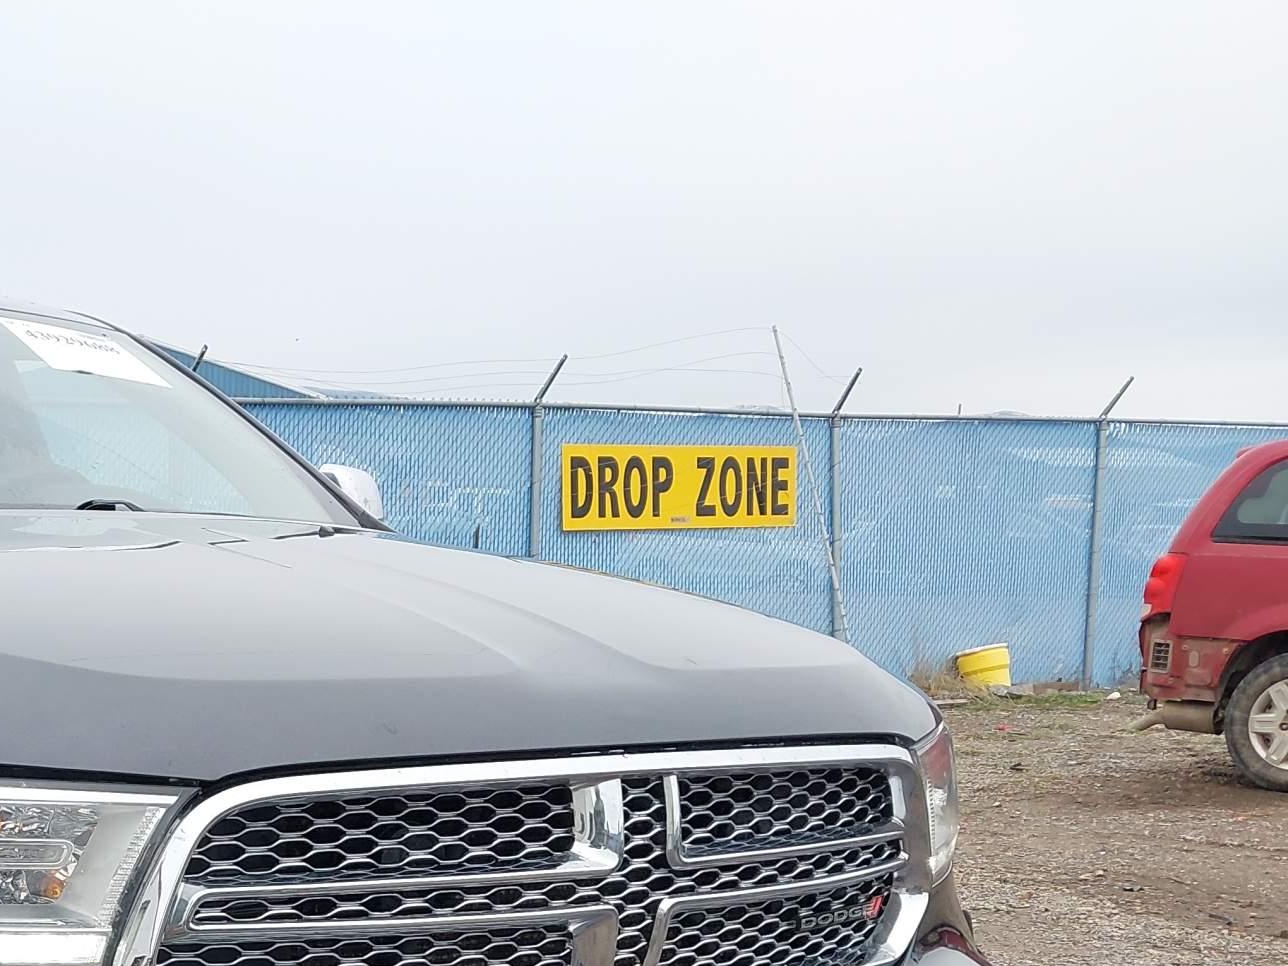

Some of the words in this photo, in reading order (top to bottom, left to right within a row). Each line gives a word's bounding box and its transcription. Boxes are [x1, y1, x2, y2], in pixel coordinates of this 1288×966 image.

[570, 455, 674, 518] DROP
[695, 456, 790, 517] ZONE
[800, 903, 872, 929] DODGE
